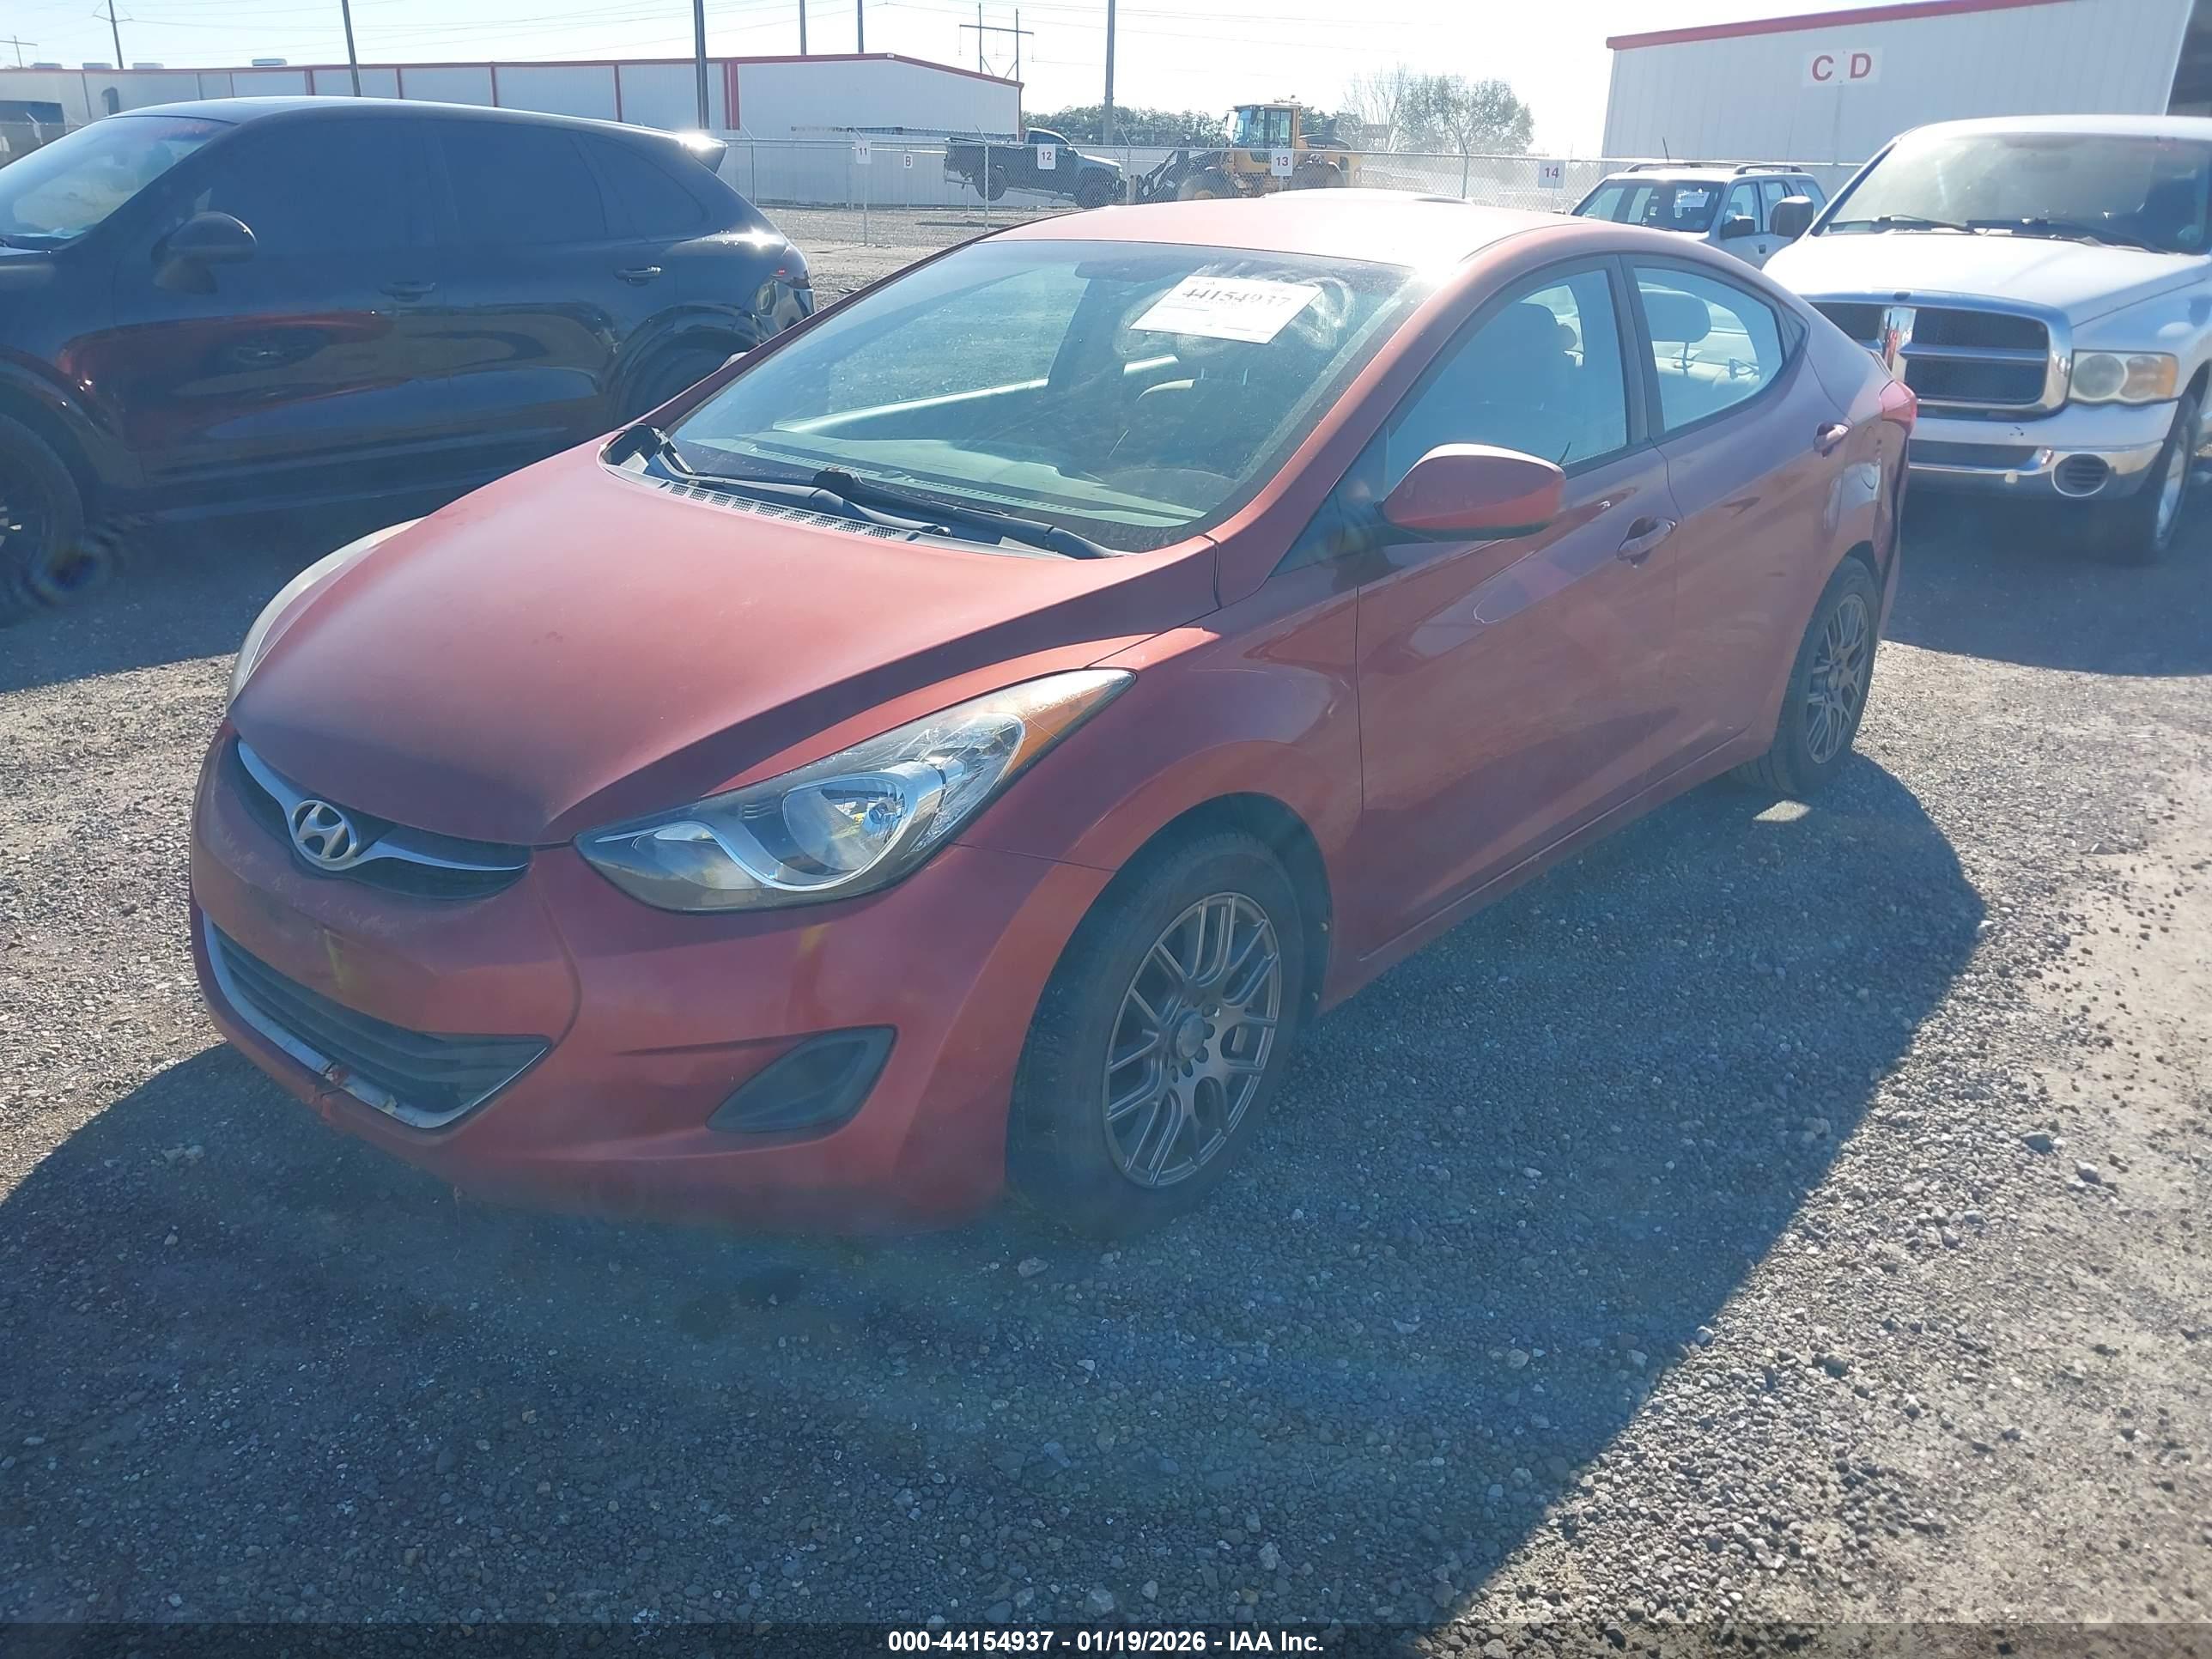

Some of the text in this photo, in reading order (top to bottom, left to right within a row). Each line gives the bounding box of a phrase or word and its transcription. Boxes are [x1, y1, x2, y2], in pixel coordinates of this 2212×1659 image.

[1812, 52, 1872, 82] C D
[859, 147, 867, 155] 11
[1042, 151, 1052, 161] 12
[1276, 156, 1289, 166] 13
[1545, 167, 1559, 179] 14
